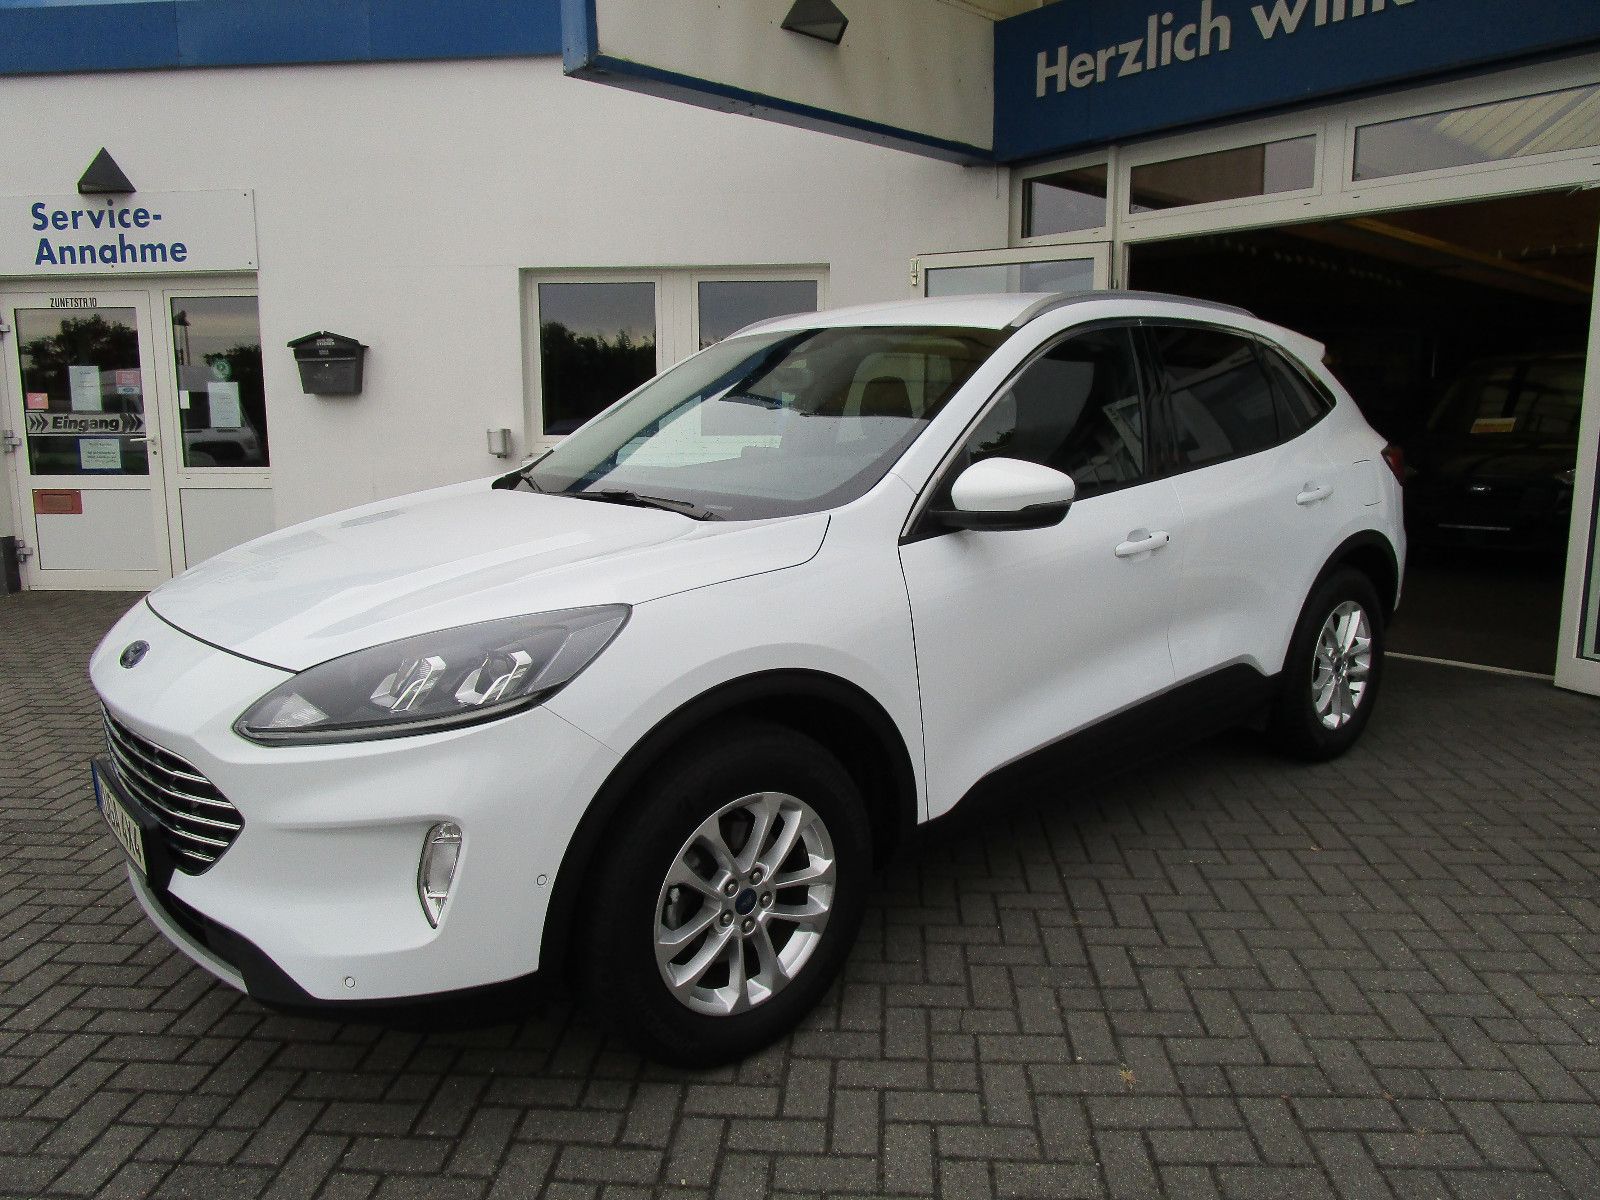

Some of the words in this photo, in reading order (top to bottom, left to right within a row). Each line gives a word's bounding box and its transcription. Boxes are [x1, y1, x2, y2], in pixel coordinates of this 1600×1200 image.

[1036, 0, 1231, 98] Herzlich
[31, 199, 162, 231] Service-
[35, 233, 188, 265] Annahme
[52, 415, 120, 433] Eingang
